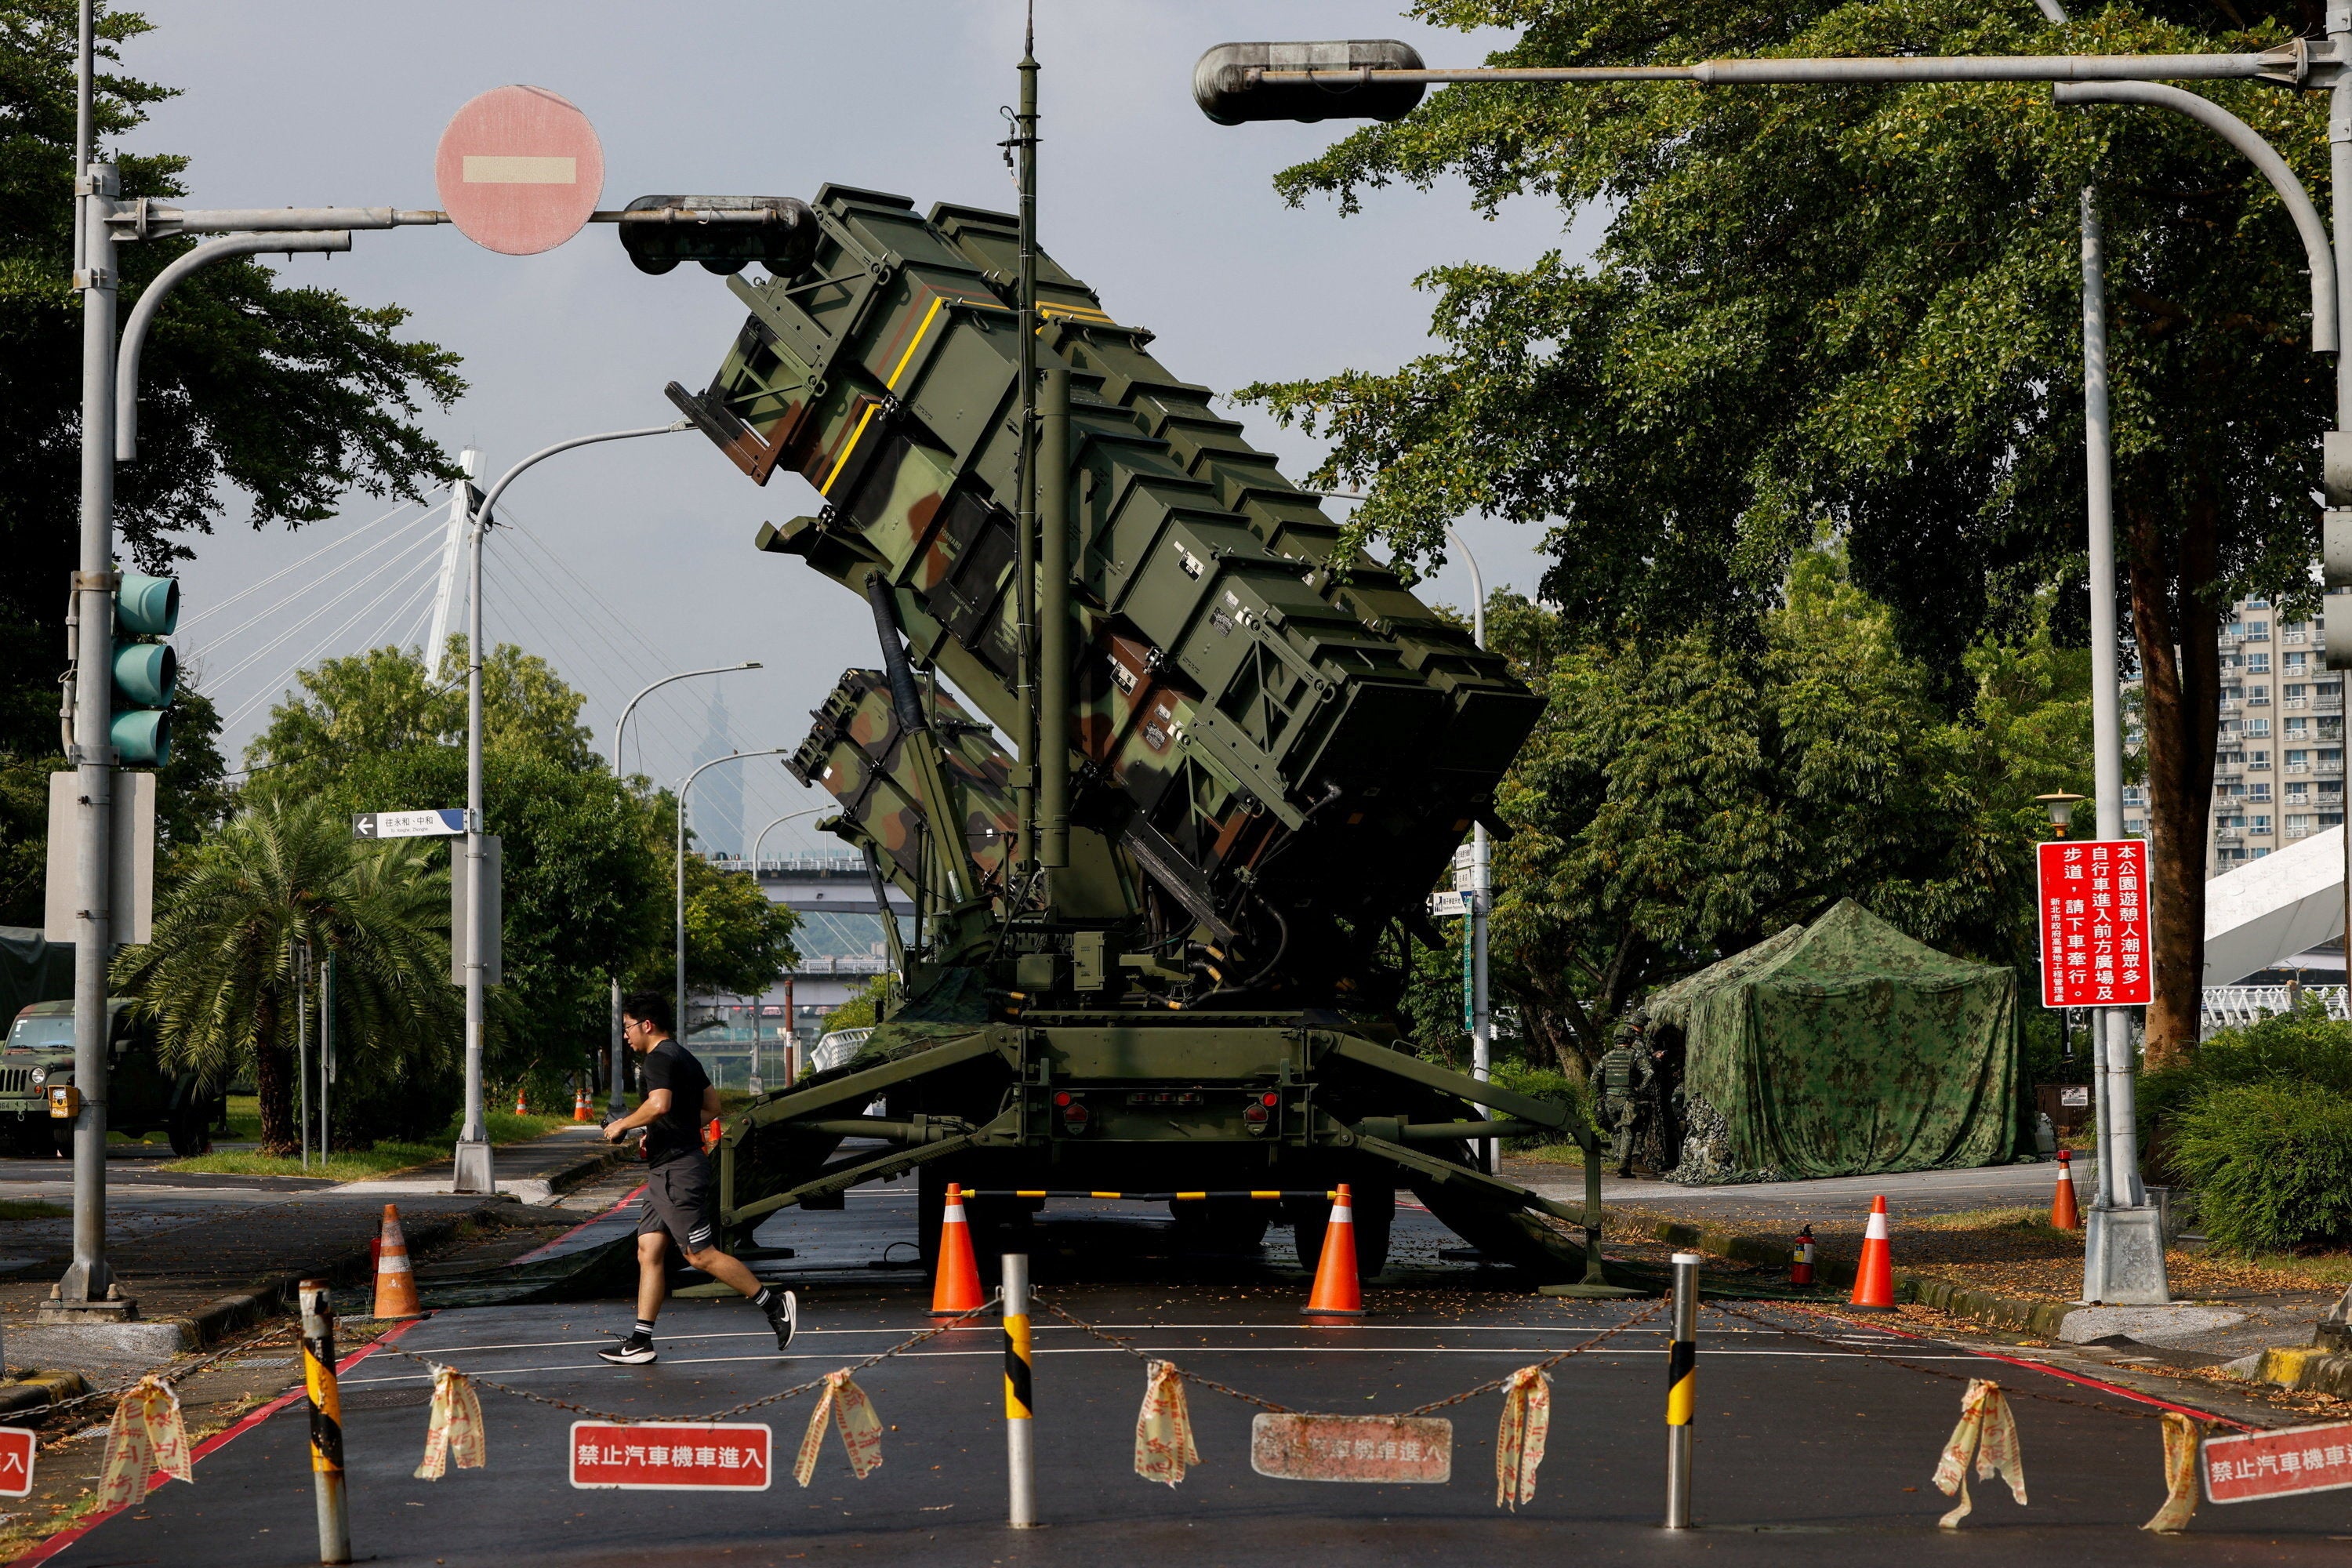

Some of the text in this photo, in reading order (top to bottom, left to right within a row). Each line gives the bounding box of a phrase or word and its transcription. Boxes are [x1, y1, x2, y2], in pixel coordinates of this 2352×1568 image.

[385, 816, 434, 827] 往永和、中和
[2091, 846, 2114, 1000] 自行車進入前方廣場及
[2050, 898, 2064, 1003] 新北市政府高灘地工程管理處
[578, 1444, 764, 1468] 禁止汽車機車進入
[2211, 1443, 2352, 1483] 禁止汽車機車
